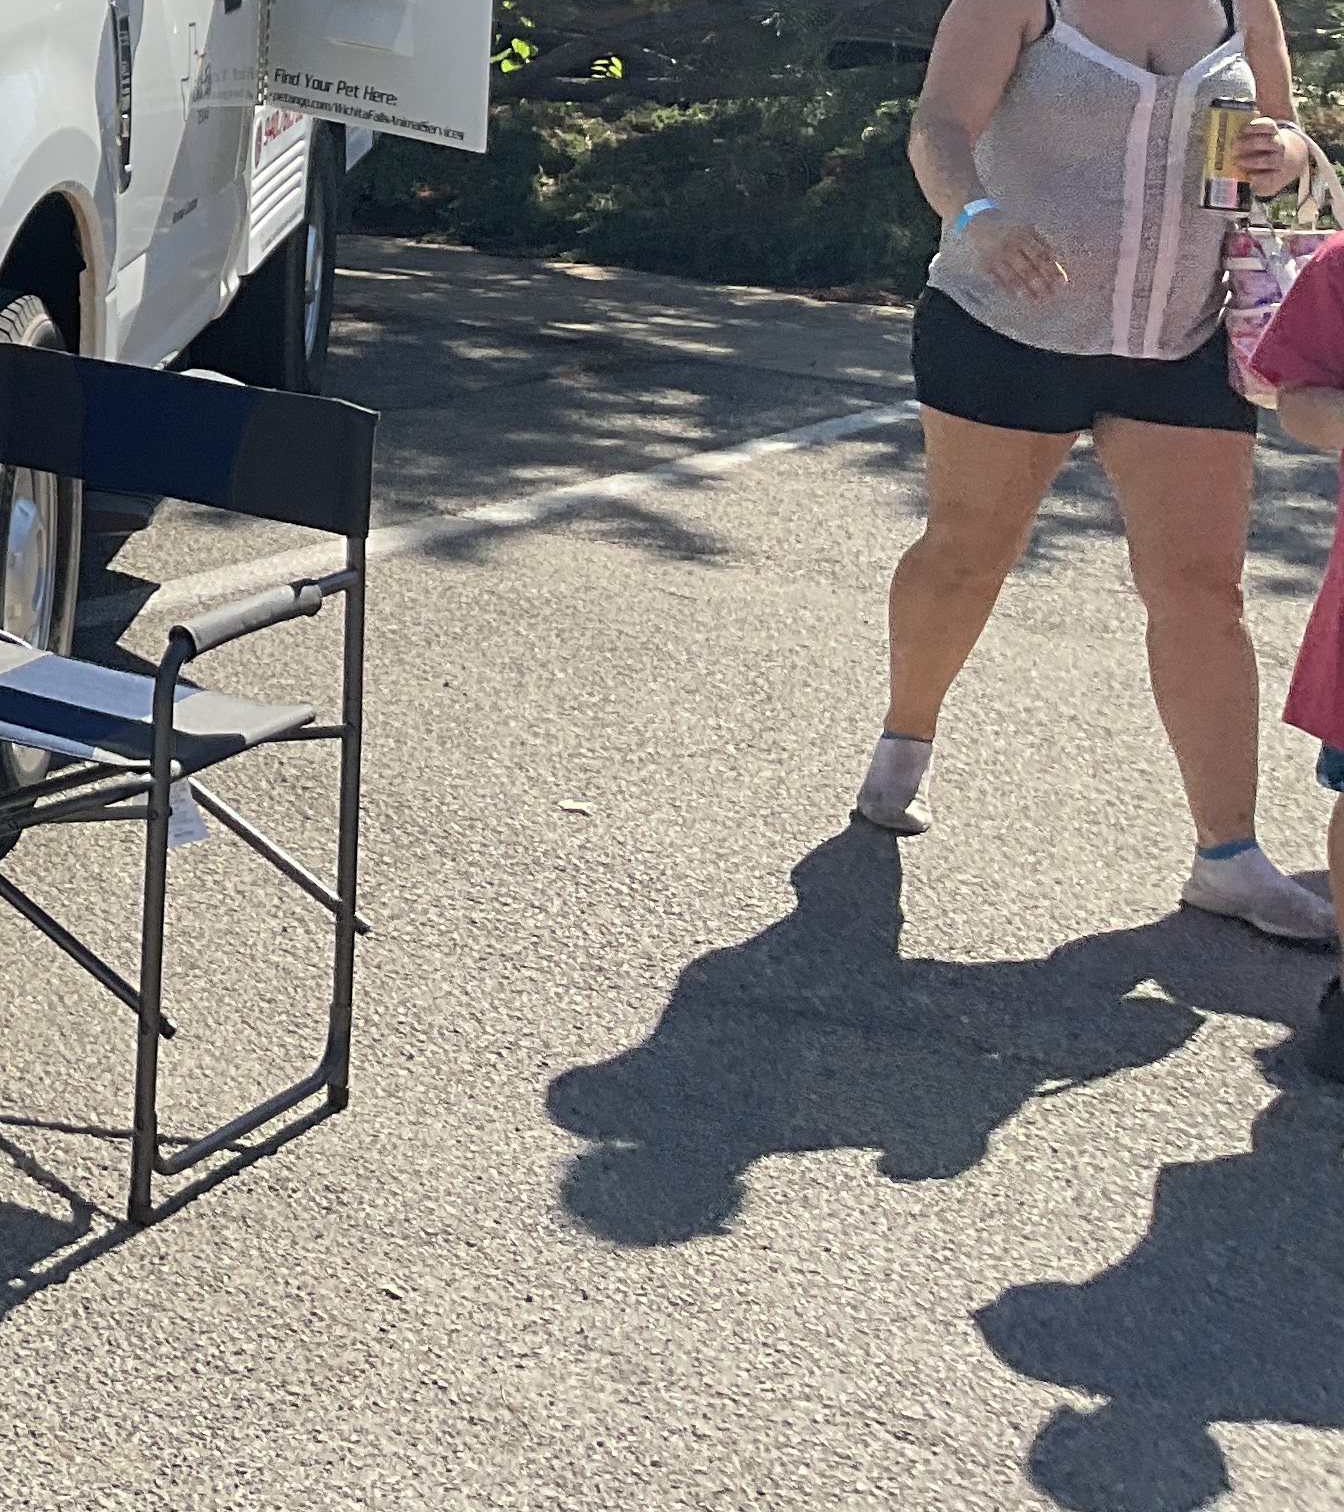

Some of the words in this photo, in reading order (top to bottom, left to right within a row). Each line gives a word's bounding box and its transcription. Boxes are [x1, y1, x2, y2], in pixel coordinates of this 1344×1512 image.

[274, 68, 301, 86] Find
[305, 74, 334, 93] Your
[337, 81, 361, 99] Pet
